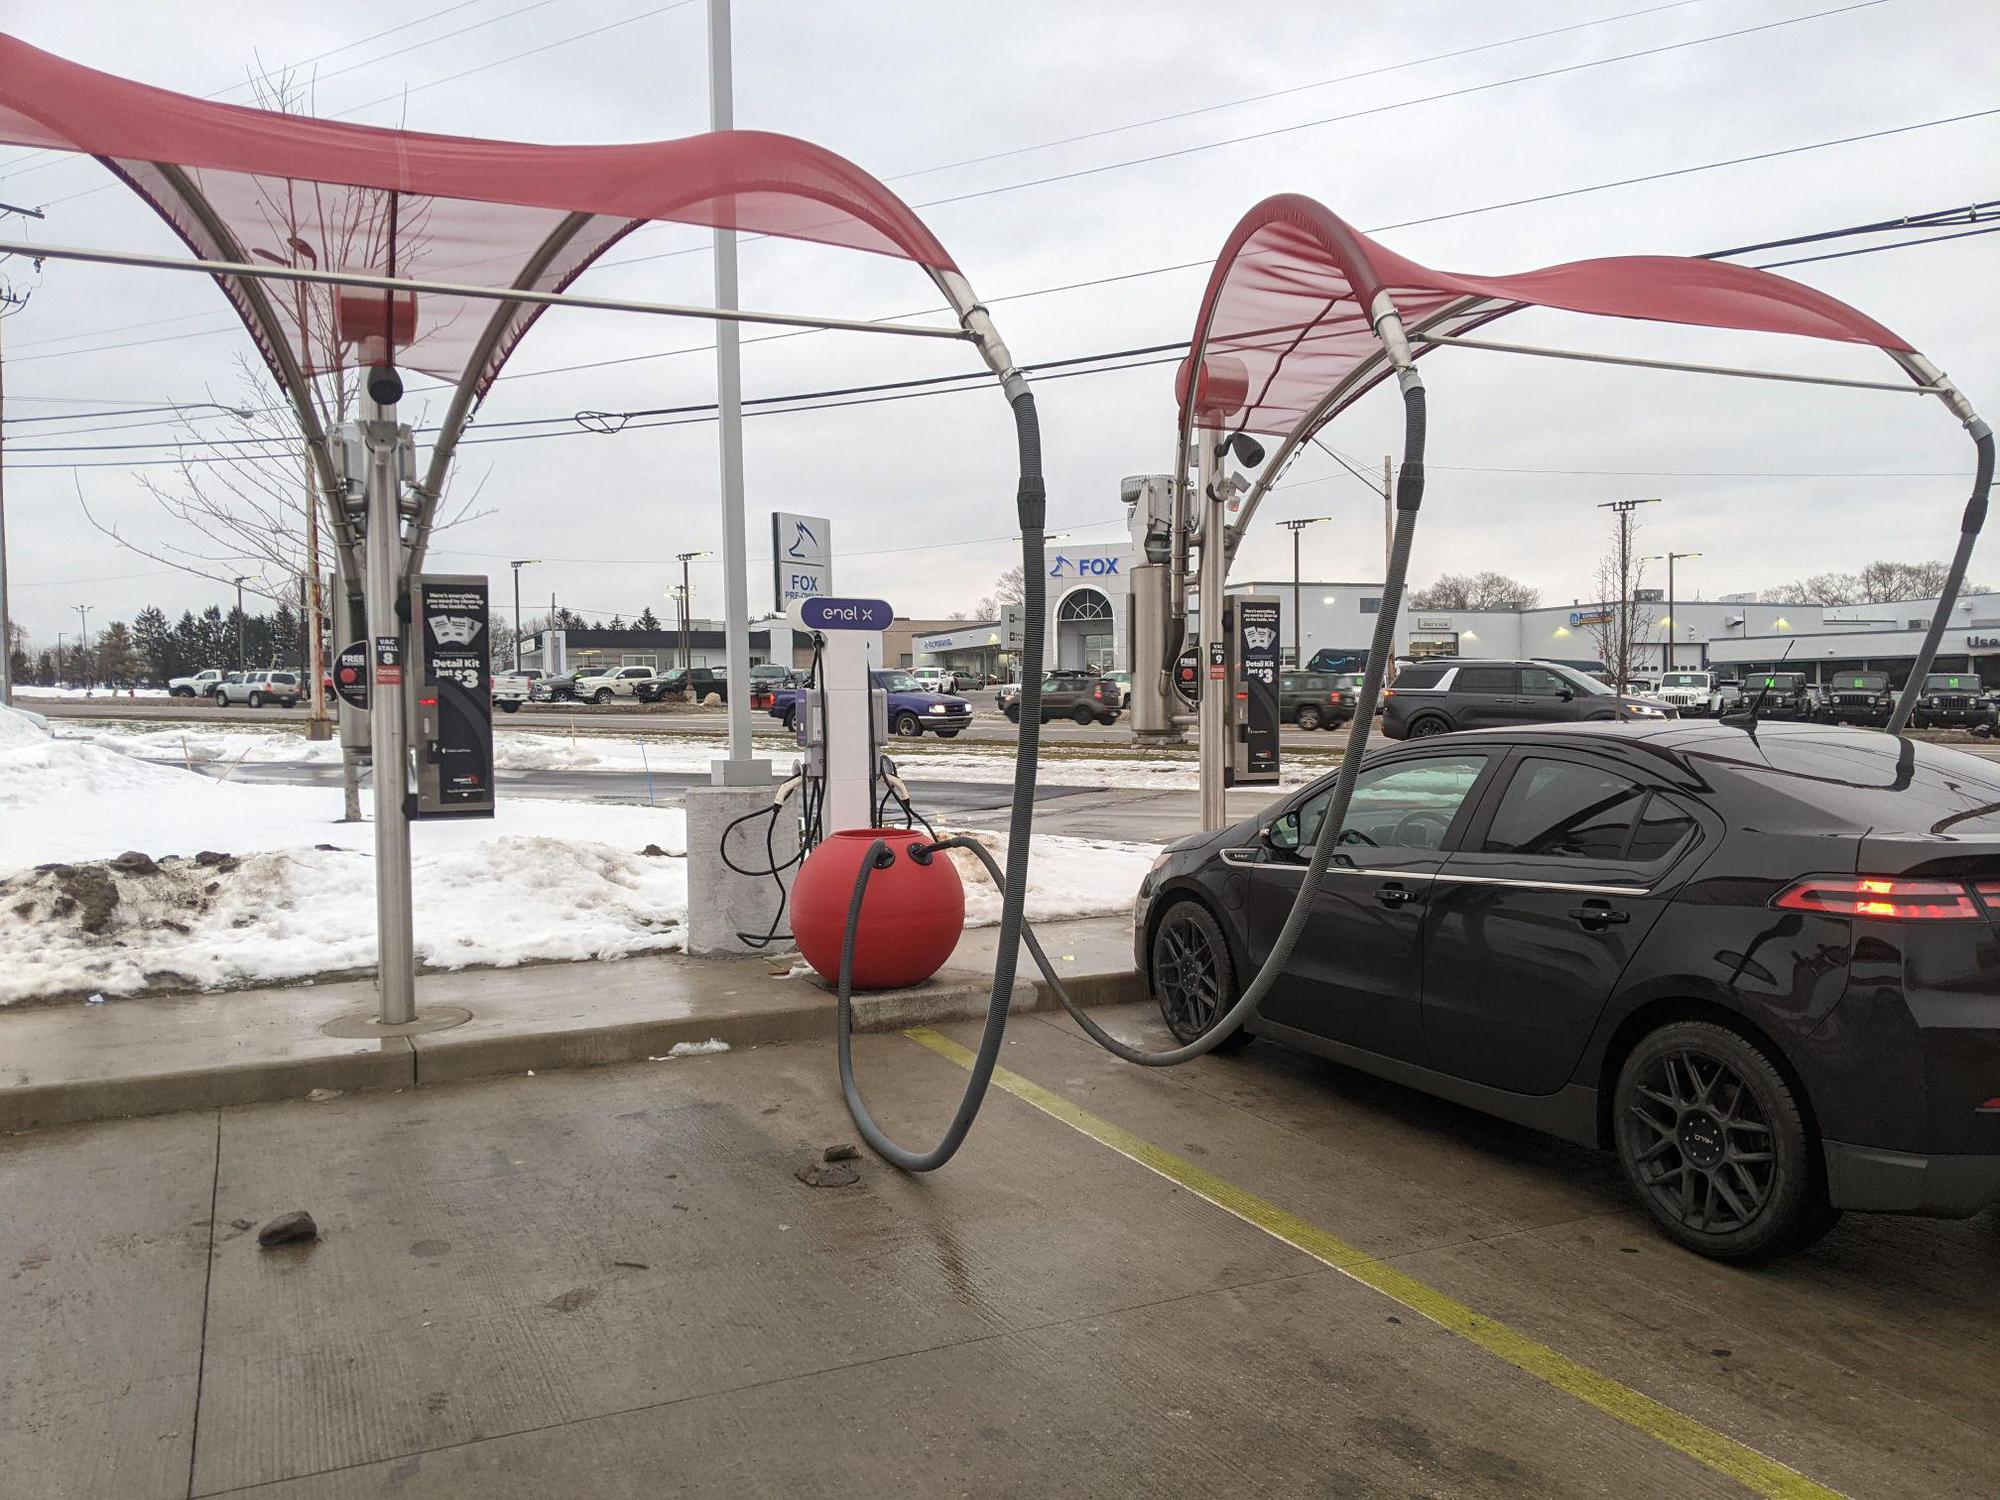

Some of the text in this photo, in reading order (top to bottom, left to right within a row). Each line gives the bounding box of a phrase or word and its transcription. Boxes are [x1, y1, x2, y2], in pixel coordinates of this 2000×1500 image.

[1079, 558, 1119, 576] FOX
[791, 575, 818, 591] FOX
[823, 605, 873, 621] enel x
[1967, 636, 2000, 648] Use
[341, 655, 365, 663] FREE
[382, 652, 394, 665] 8
[432, 659, 480, 668] Detail Kit
[1215, 654, 1223, 664] 9
[1246, 660, 1274, 668] Detail Kit
[435, 668, 479, 689] just $3
[1247, 667, 1273, 684] just $3
